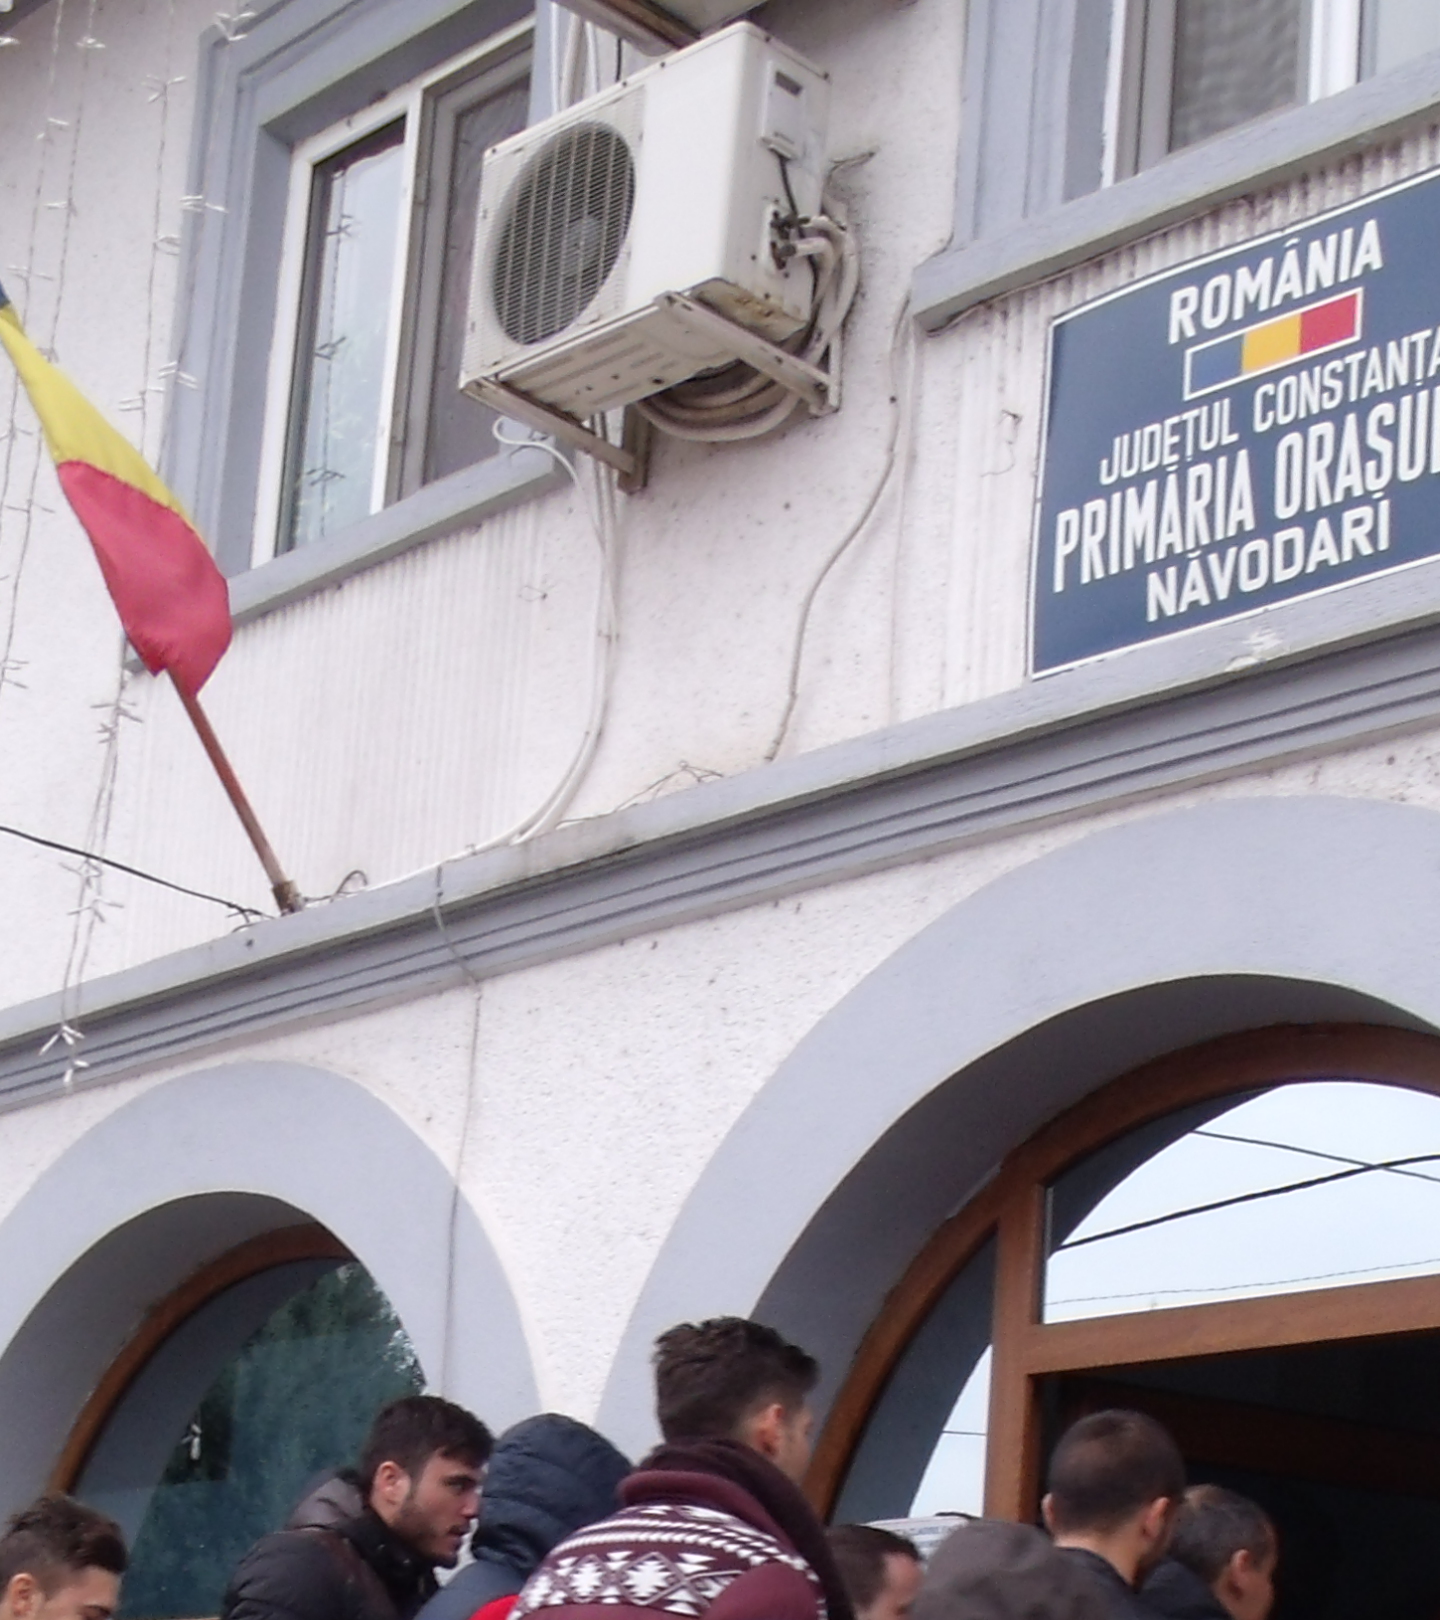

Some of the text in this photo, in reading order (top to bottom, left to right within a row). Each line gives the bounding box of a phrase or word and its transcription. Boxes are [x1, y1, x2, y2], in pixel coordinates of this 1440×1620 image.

[1168, 219, 1383, 344] ROMÂNIA
[1053, 449, 1254, 592] PRIMĂRIA
[1147, 500, 1390, 622] NĂVODARI
